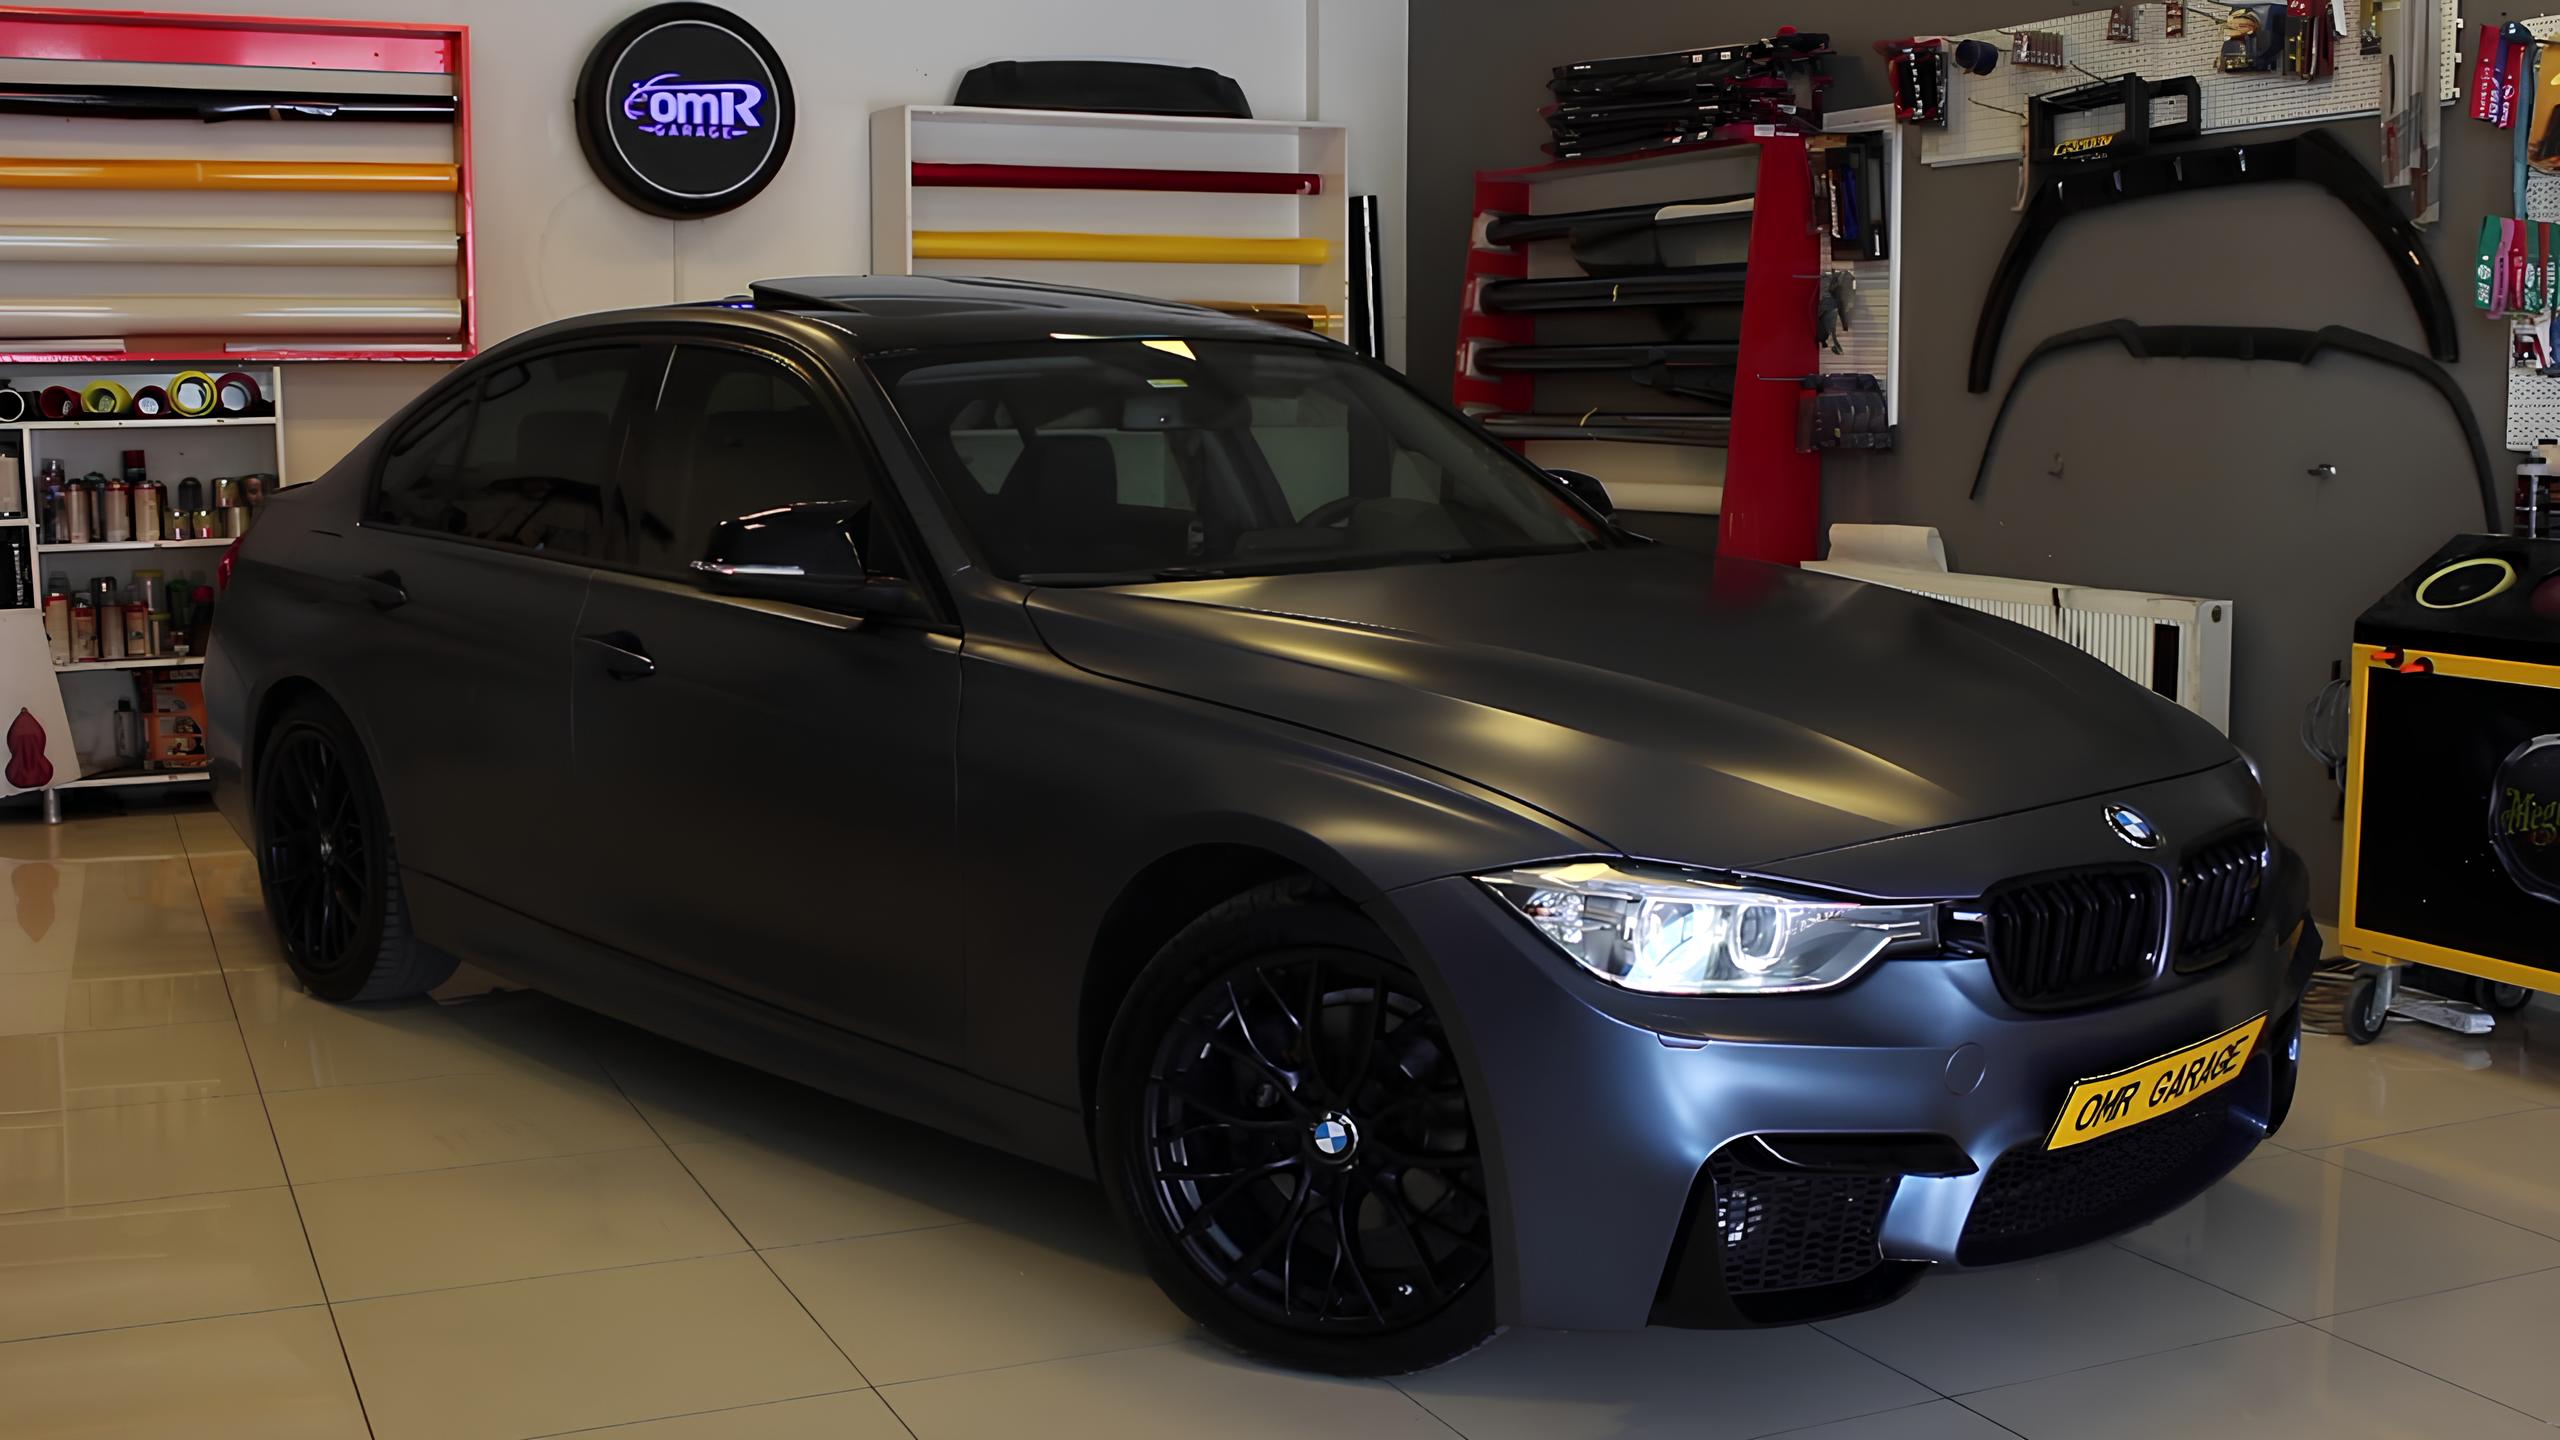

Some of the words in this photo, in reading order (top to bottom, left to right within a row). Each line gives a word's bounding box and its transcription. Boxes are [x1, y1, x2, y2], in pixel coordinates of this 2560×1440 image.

[654, 124, 733, 139] GARAGE
[2501, 787, 2560, 846] Meg
[2075, 1081, 2141, 1131] OMR
[2150, 1035, 2249, 1107] GARAGE
